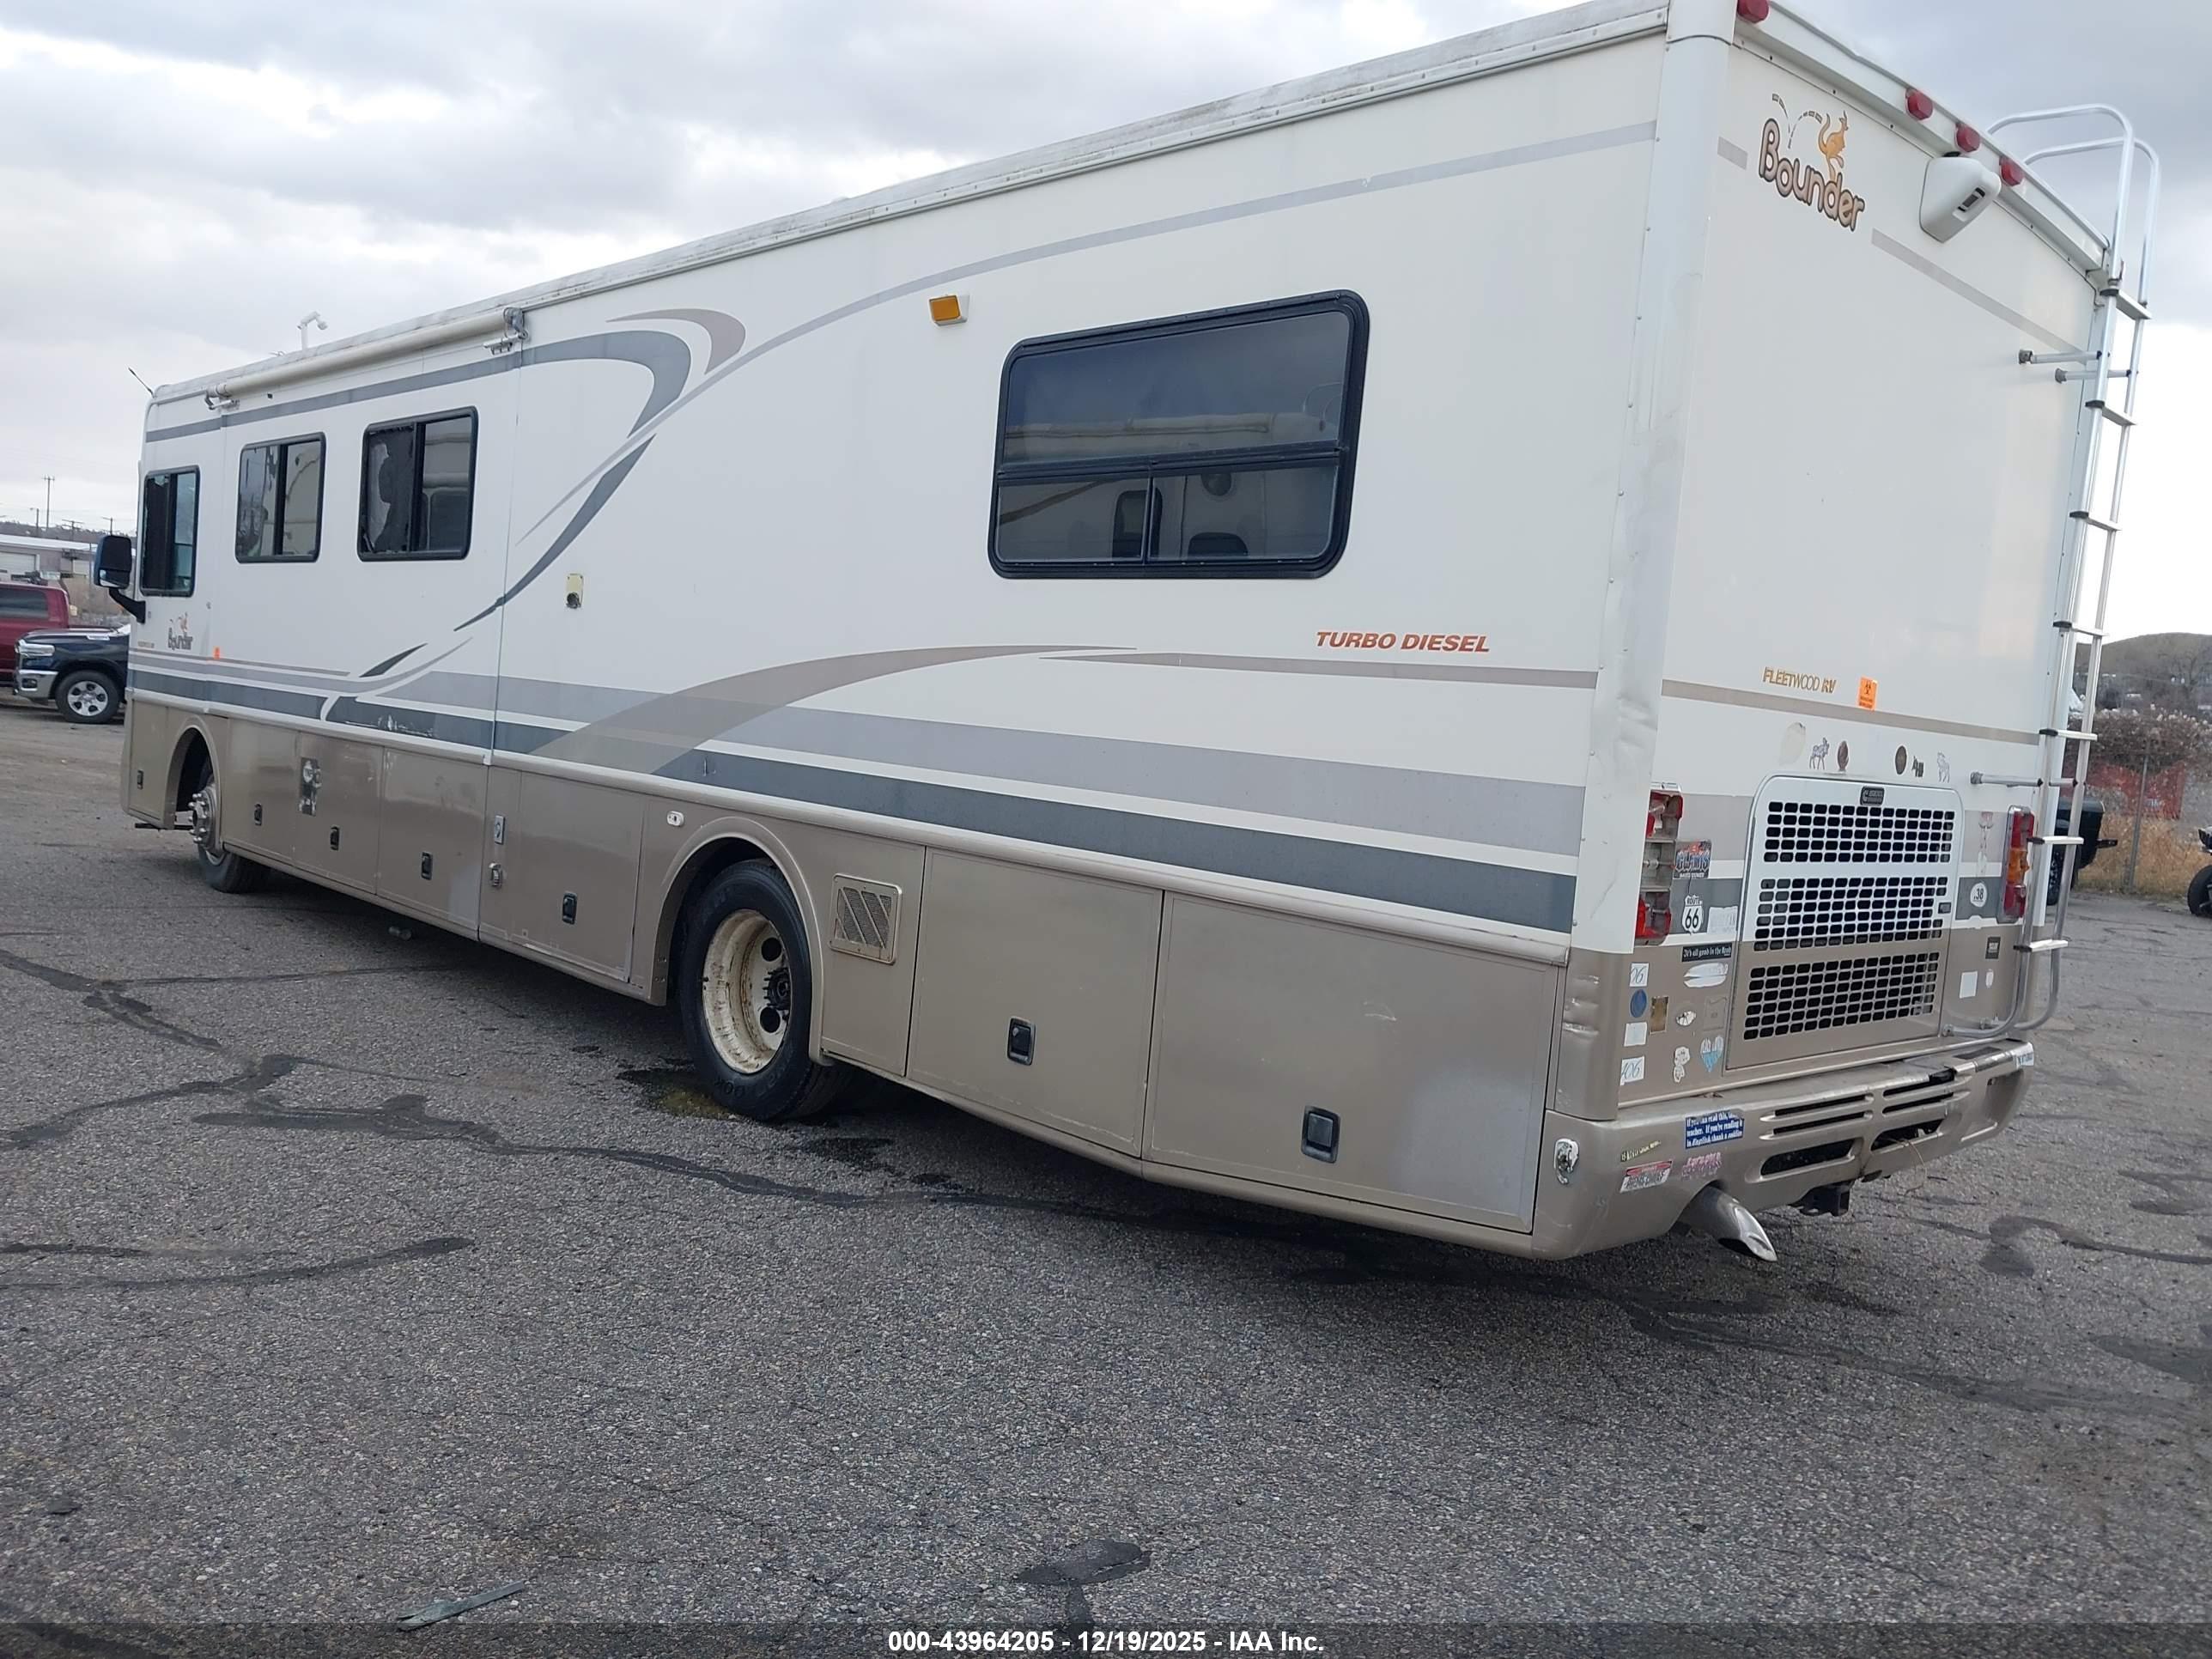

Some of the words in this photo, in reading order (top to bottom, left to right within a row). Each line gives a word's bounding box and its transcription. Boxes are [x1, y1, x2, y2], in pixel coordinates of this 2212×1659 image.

[1758, 117, 1866, 233] Bounder
[1316, 631, 1397, 650] TURBO
[1401, 634, 1491, 653] DIESEL
[1762, 665, 1820, 692] FLEETWOOD
[1820, 678, 1838, 694] RV
[1685, 908, 1699, 929] 66
[1686, 1117, 1692, 1127] If
[1708, 1113, 1718, 1122] read
[1705, 1124, 1711, 1134] If
[1711, 1121, 1723, 1134] you're
[1723, 1119, 1740, 1131] reading
[1686, 1139, 1692, 1148] in
[1711, 1131, 1724, 1142] thank
